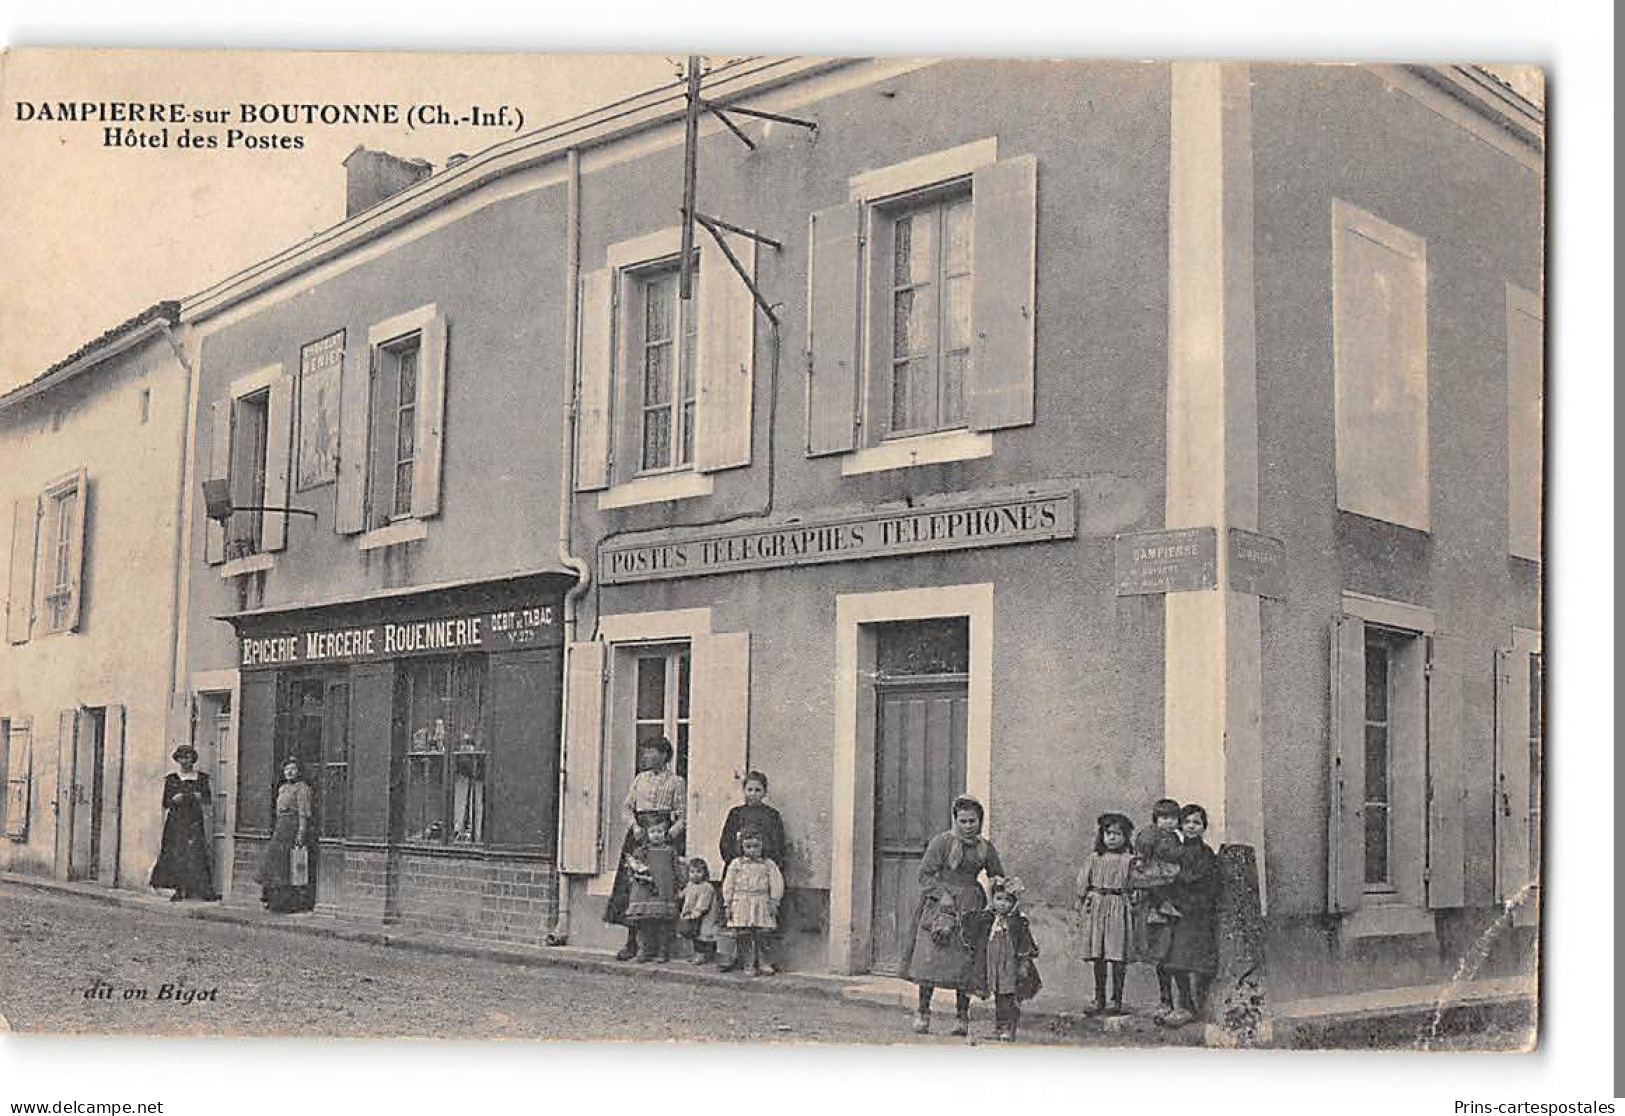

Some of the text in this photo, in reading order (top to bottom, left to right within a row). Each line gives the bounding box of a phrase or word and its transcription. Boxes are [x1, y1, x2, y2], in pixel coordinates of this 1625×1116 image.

[611, 502, 1058, 574] POSTES TELEGRAPHES TELEPHONES
[1133, 544, 1200, 561] DAMPIERRE
[523, 606, 552, 629] TABAC
[243, 618, 483, 665] EPICERIE MERCERIE ROUENNERIE
